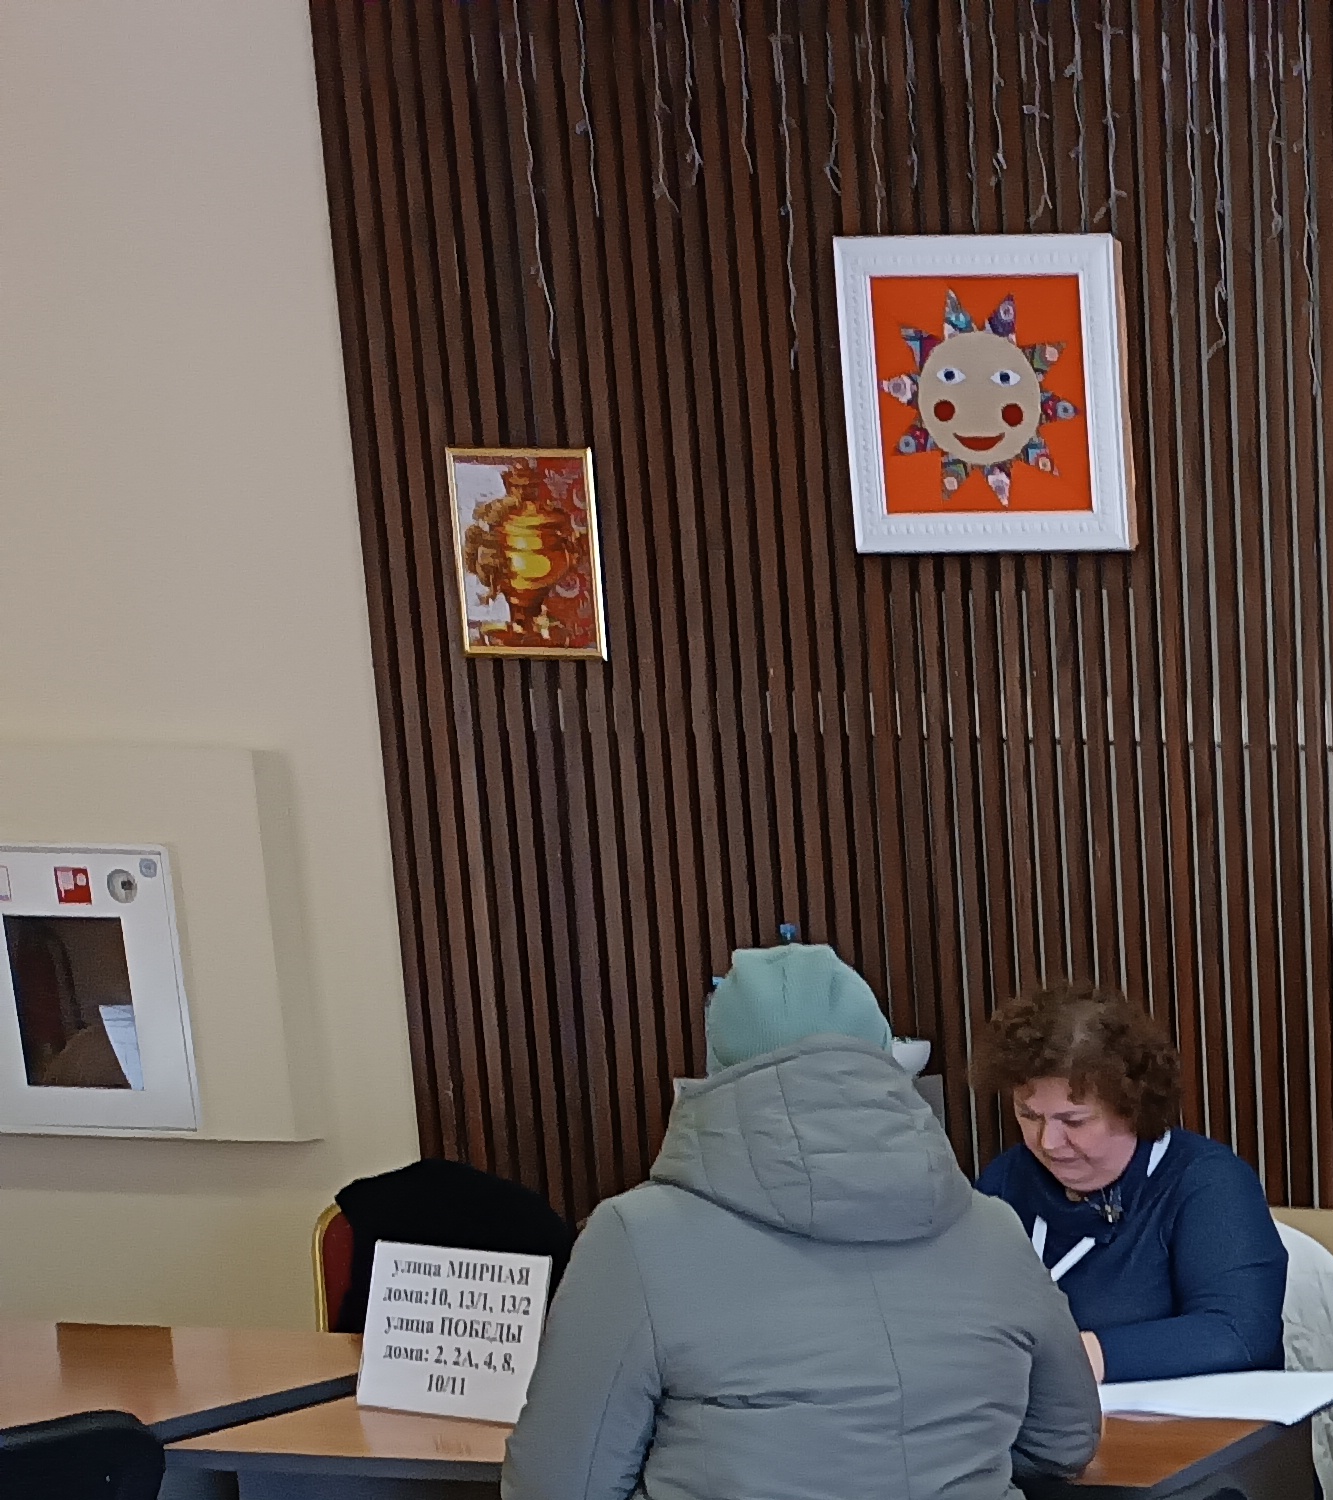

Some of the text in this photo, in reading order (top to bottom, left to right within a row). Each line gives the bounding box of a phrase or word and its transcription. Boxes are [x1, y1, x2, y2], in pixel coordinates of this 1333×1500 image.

[391, 1259, 531, 1286] улица МИРНАЯ
[458, 1290, 494, 1313] 13/1,
[501, 1295, 531, 1316] 13/2
[384, 1316, 523, 1344] улица ПОБЕДЫ
[382, 1344, 429, 1362] дома:
[433, 1345, 448, 1366] 2,
[483, 1351, 497, 1374] 4,
[501, 1352, 515, 1375] 8,
[427, 1373, 466, 1396] 10/11
